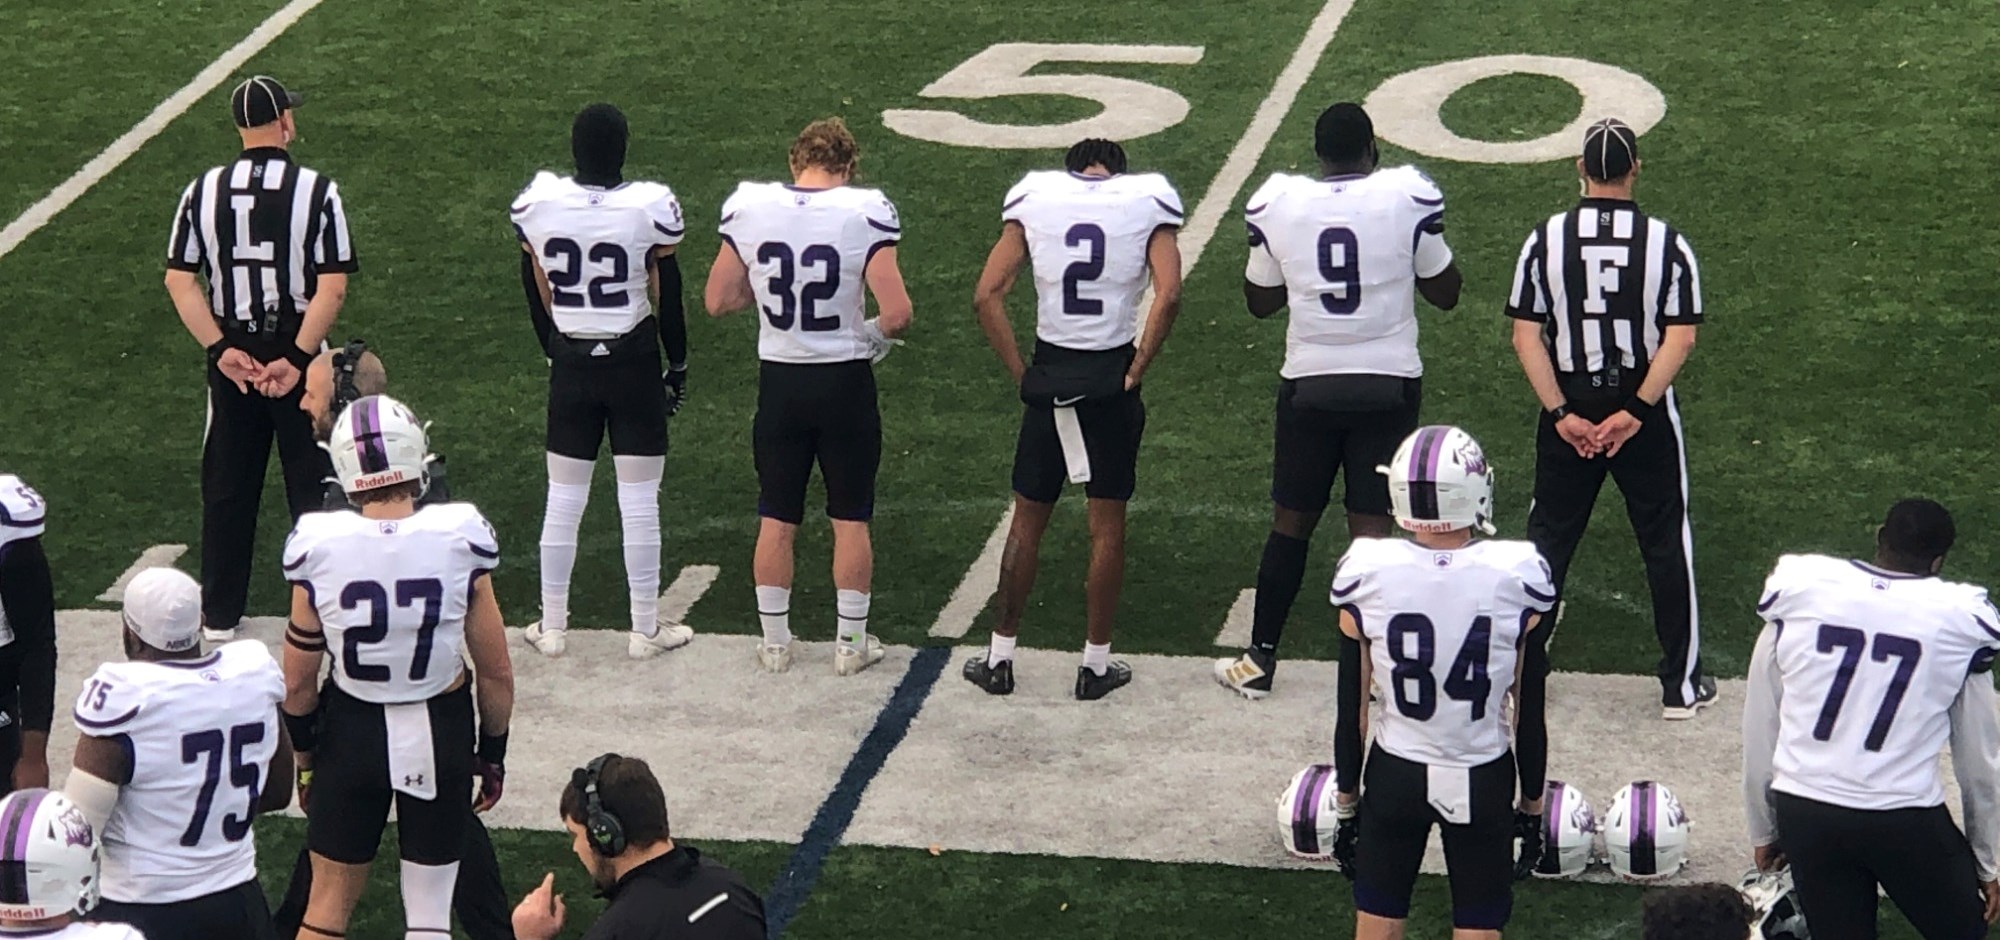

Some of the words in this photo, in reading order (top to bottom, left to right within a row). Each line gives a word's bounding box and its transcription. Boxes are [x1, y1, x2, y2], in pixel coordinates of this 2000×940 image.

[231, 195, 274, 261] L
[544, 237, 630, 308] 22
[1063, 223, 1105, 315] 2
[1317, 227, 1361, 315] 9
[757, 241, 840, 331] 32
[1581, 246, 1629, 313] F
[354, 470, 404, 489] Riddell
[340, 578, 442, 682] 27
[1387, 612, 1492, 722] 84
[1812, 624, 1922, 752] 77
[180, 722, 264, 846] 75
